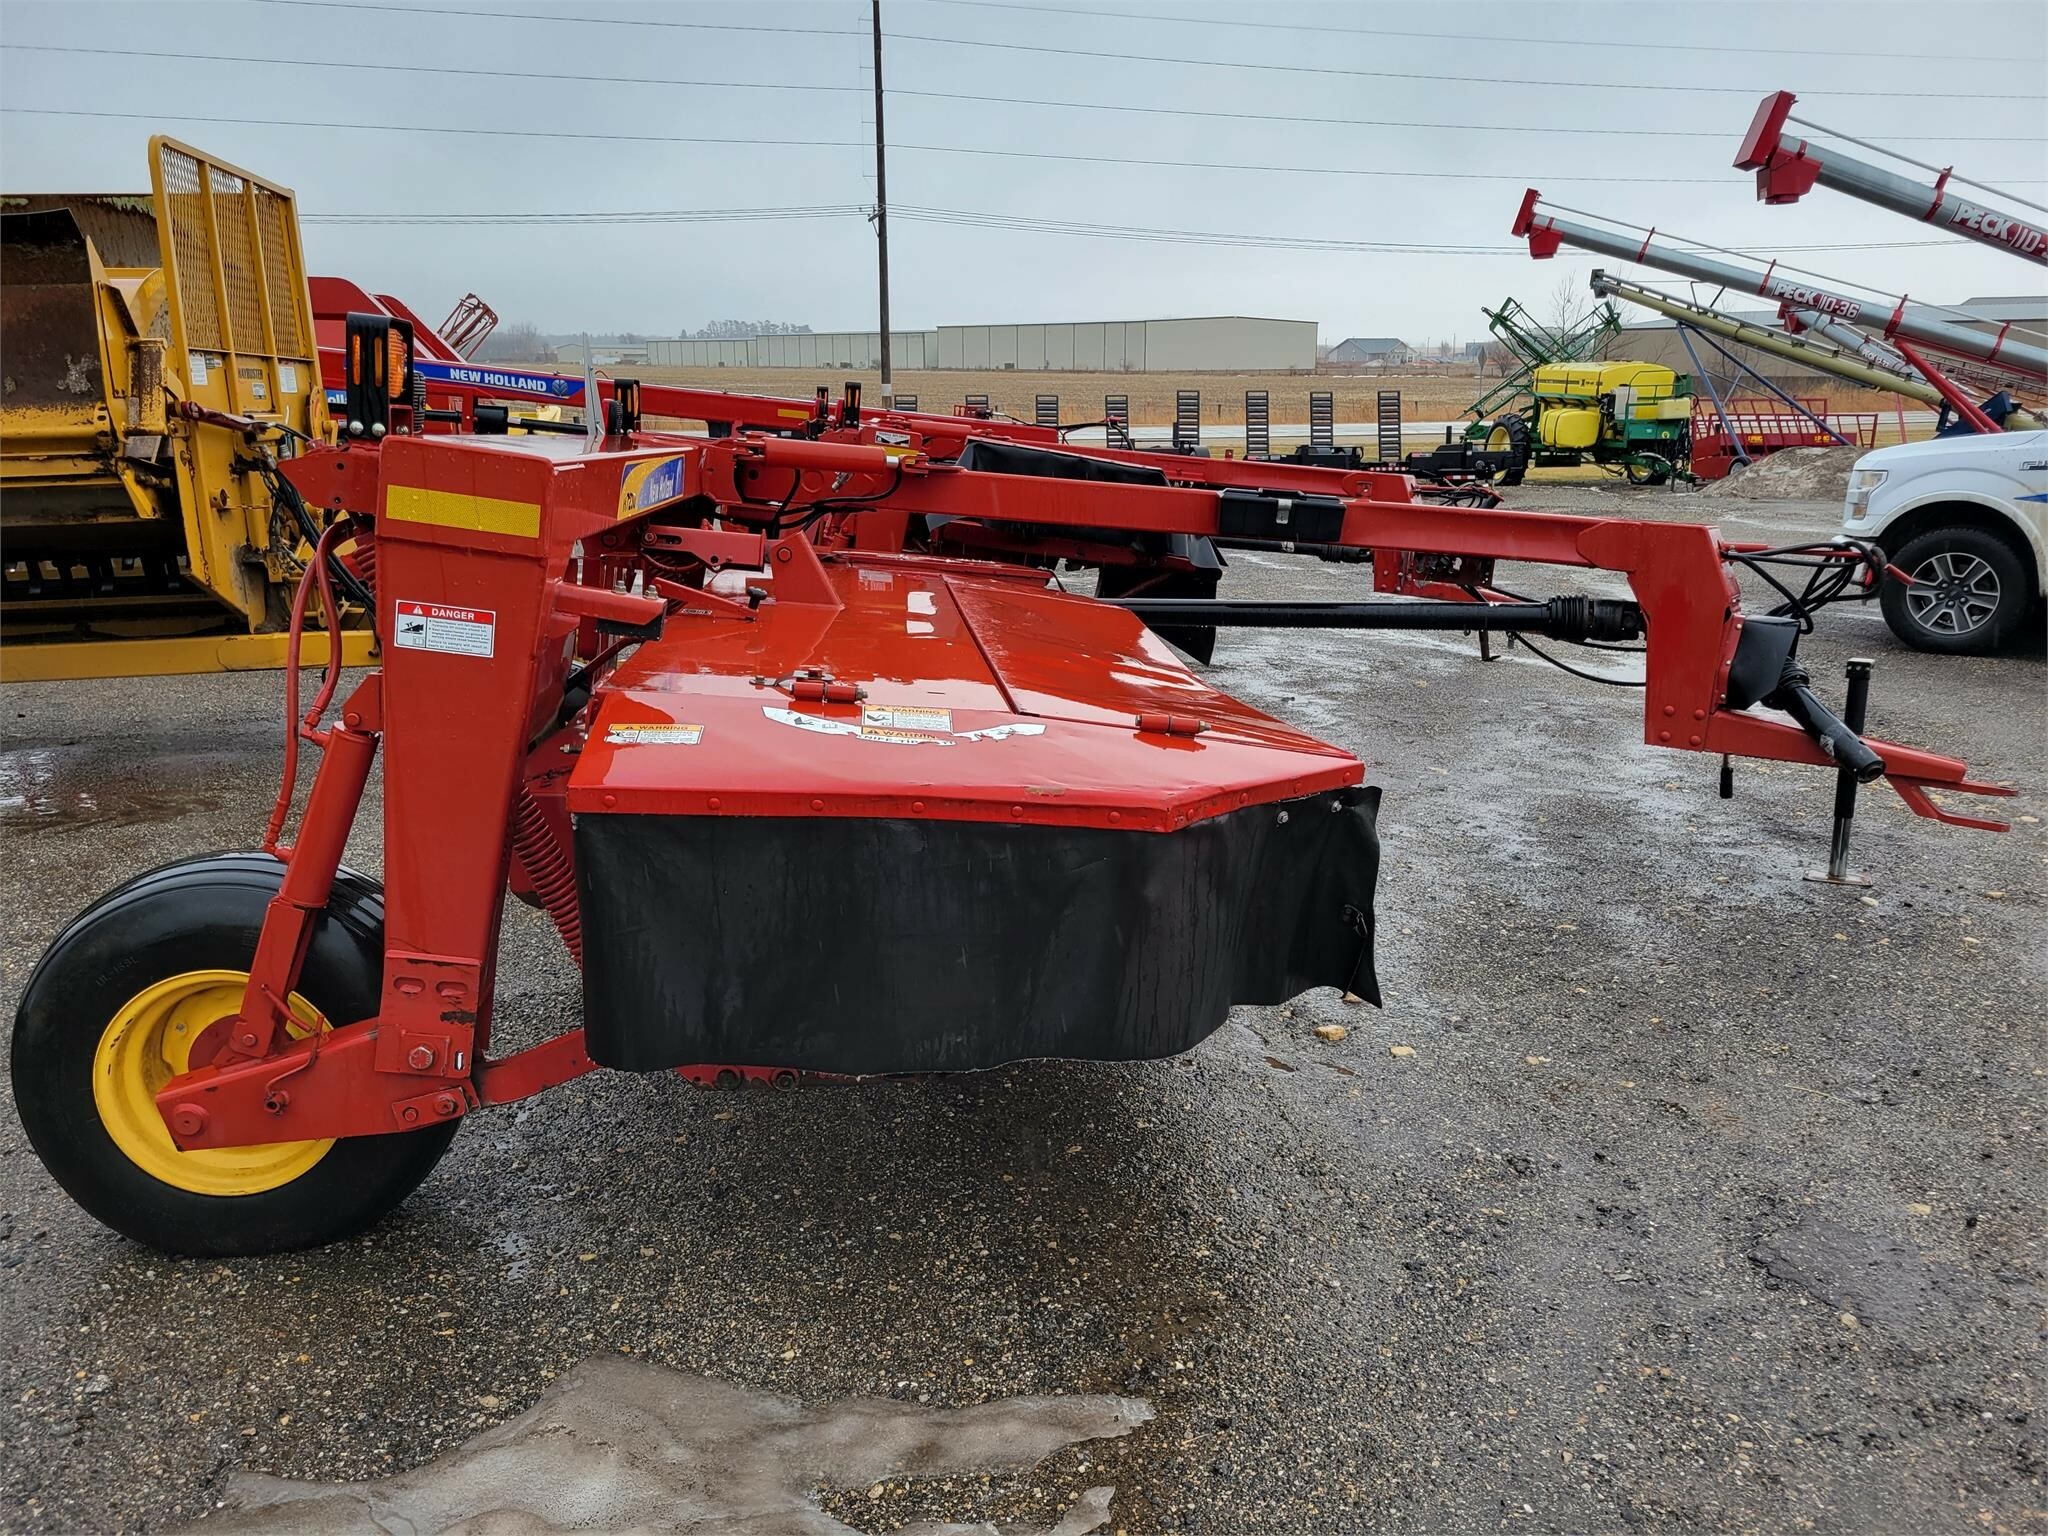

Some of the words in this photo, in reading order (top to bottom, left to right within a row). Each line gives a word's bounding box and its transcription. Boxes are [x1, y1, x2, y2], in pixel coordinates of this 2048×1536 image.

[1953, 203, 2014, 241] PECK
[2015, 228, 2048, 261] 10-
[1774, 283, 1817, 306] PECK
[1820, 296, 1860, 319] 10-36
[450, 368, 481, 383] NEW
[484, 373, 547, 392] HOLLAND
[431, 607, 475, 621] DANGER
[892, 707, 940, 715] WARNING
[640, 725, 688, 735] WARNING
[883, 730, 936, 740] WARNIN
